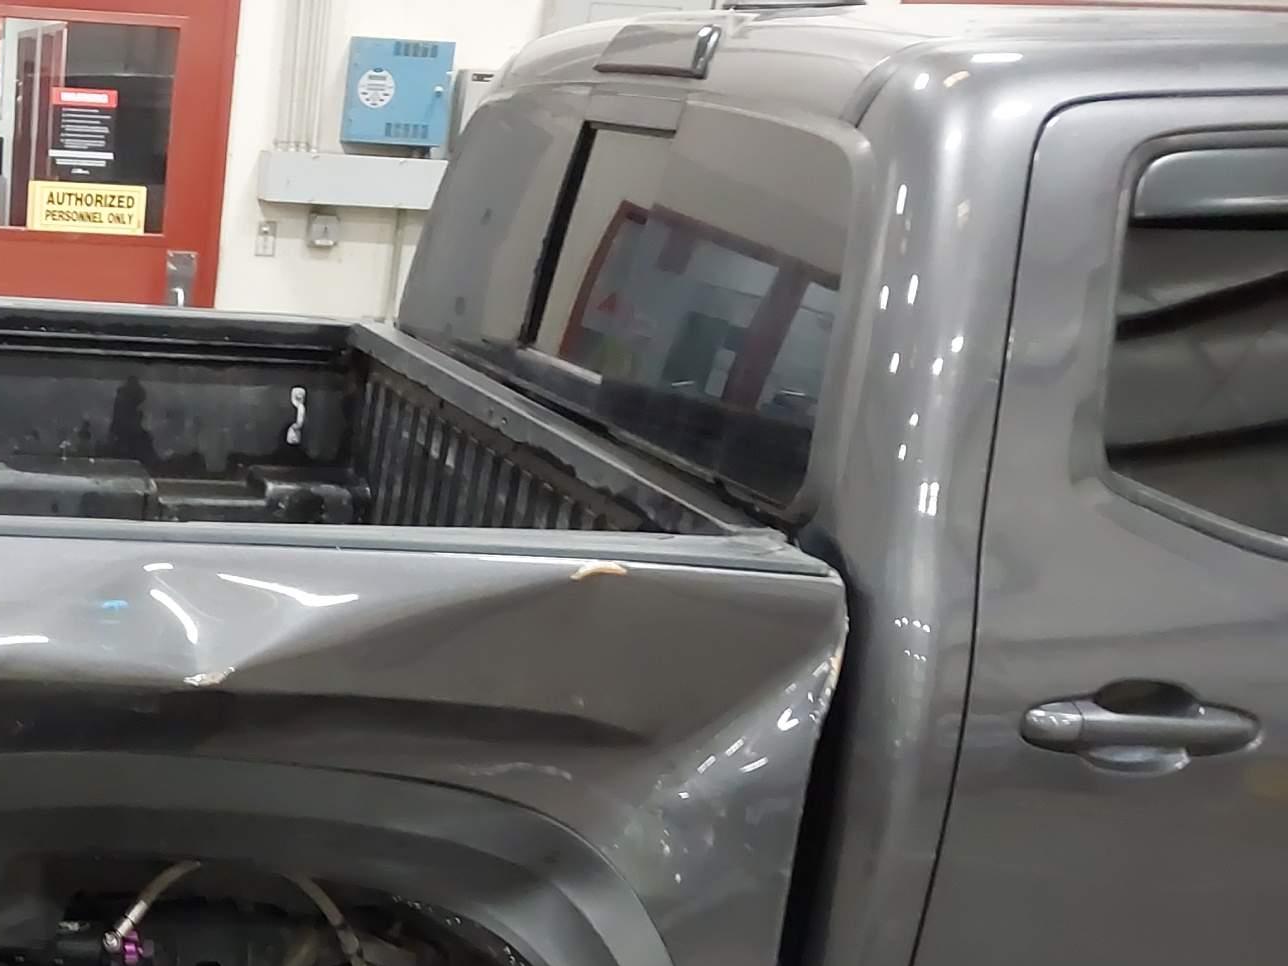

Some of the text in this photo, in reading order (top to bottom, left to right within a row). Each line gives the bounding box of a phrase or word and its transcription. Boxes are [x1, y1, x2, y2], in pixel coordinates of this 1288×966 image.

[46, 191, 135, 209] AUTHORIZED
[45, 209, 134, 225] PERSONNEL ONLY
